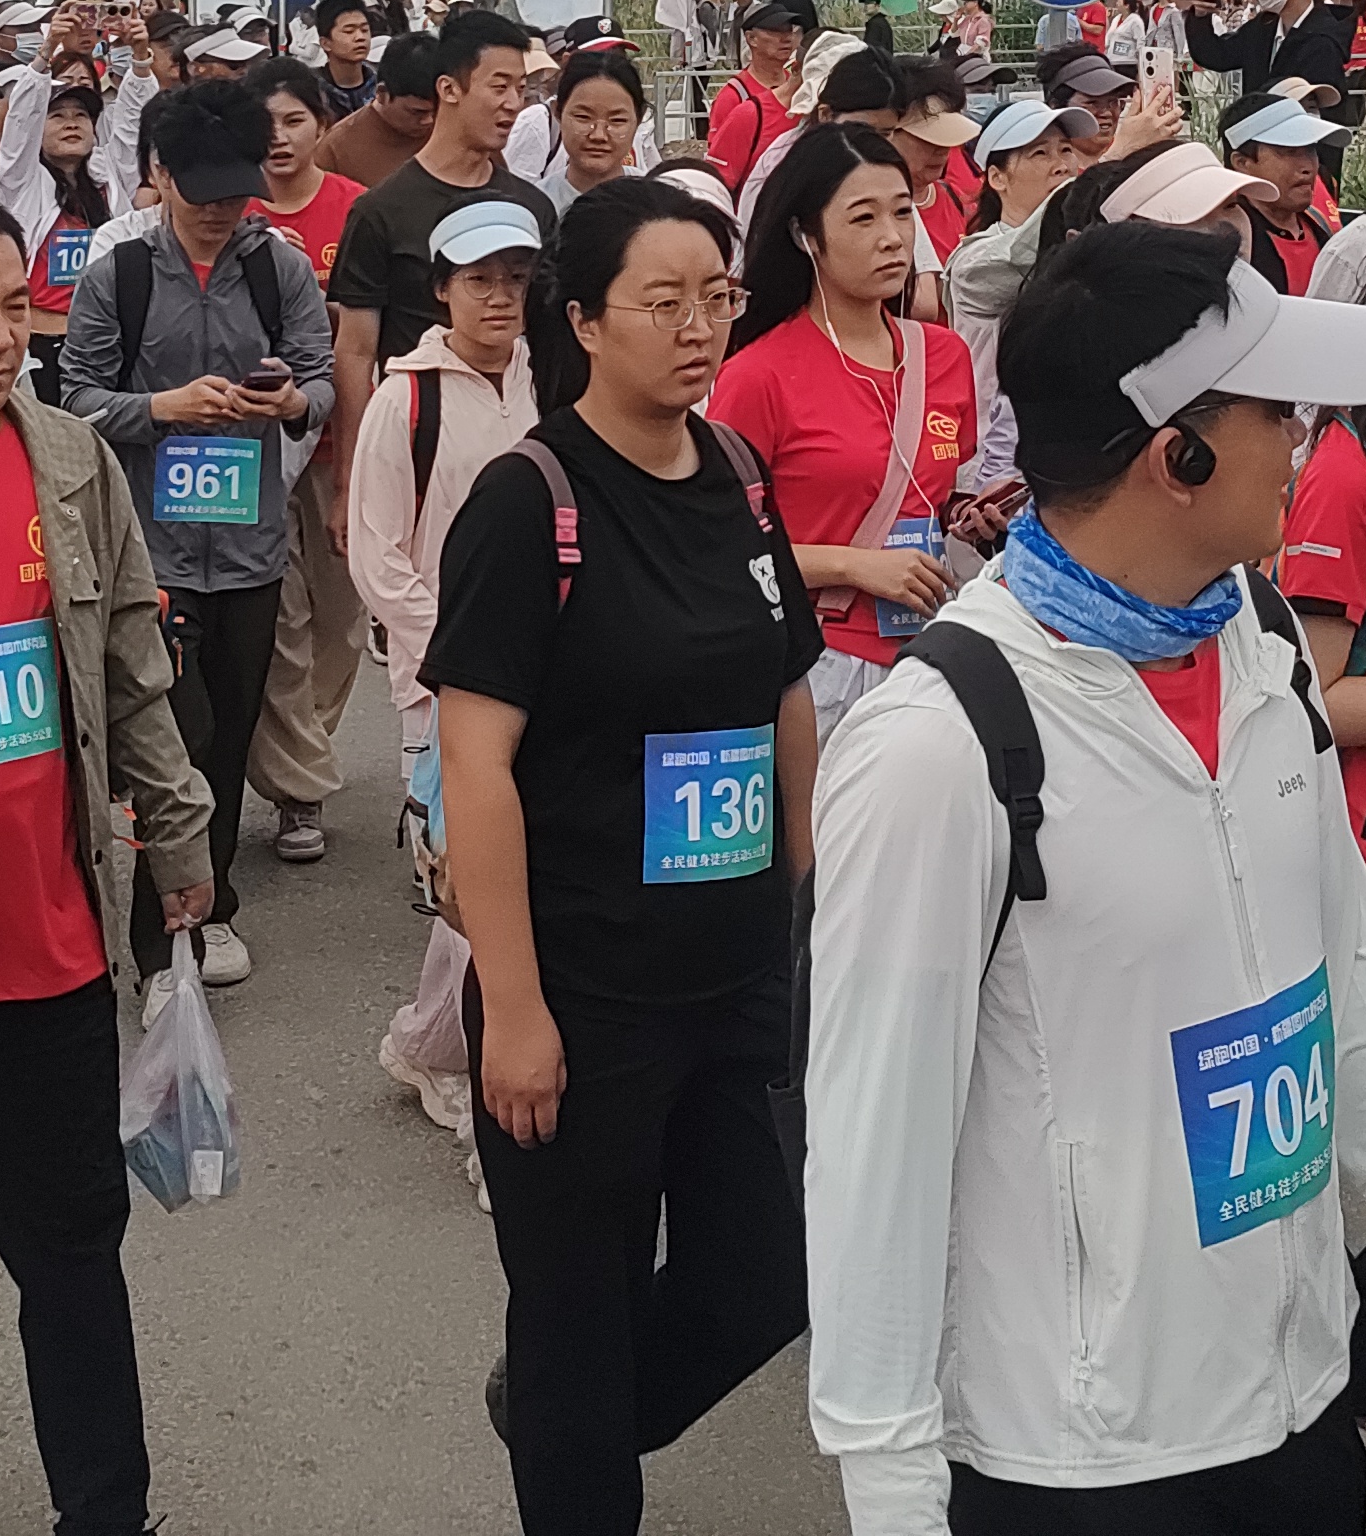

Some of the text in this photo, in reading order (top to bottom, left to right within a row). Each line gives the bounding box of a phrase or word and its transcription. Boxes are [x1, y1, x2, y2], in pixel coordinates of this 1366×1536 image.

[168, 462, 240, 500] 961
[674, 772, 765, 842] 136
[1207, 1041, 1329, 1179] 704
